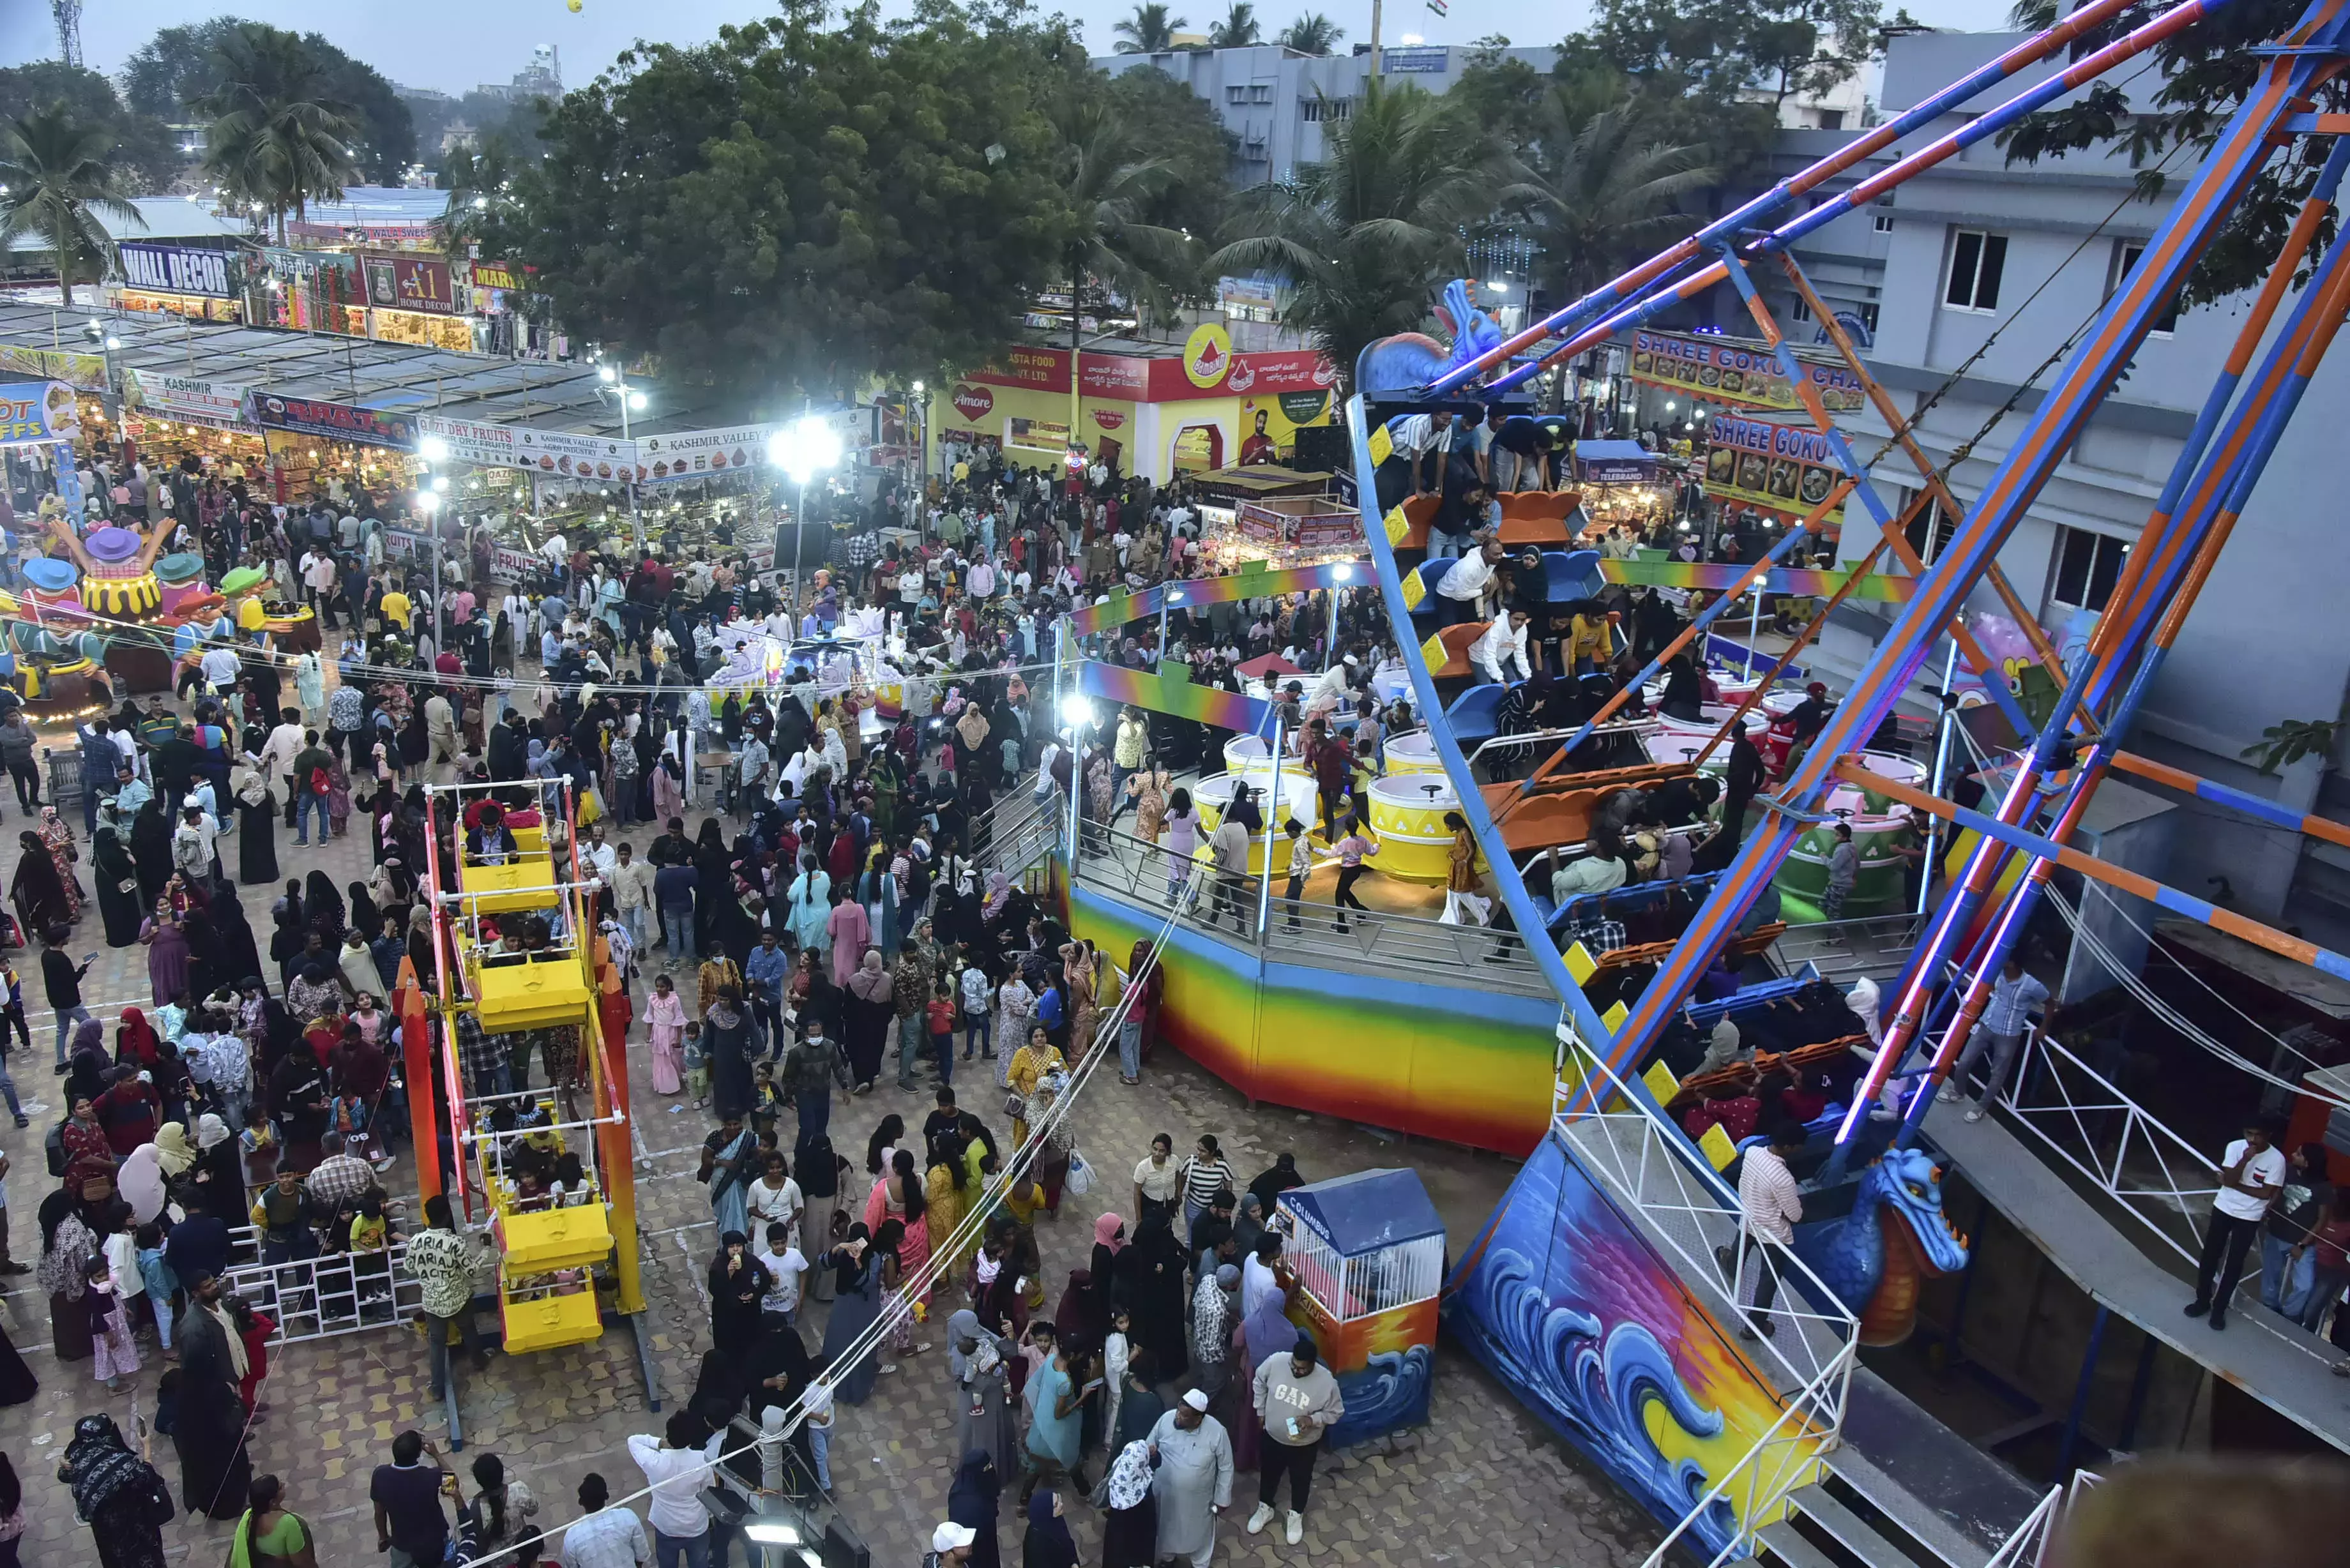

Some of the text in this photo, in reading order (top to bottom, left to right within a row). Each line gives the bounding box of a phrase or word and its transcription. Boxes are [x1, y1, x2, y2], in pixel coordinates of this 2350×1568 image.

[374, 229, 399, 238] WALA
[121, 248, 229, 292] WALL DECOR
[400, 298, 452, 313] HOME DECOR
[1031, 356, 1056, 368] FOOD
[1637, 334, 1711, 363] SHREE
[1717, 349, 1786, 378] GOKU
[1031, 370, 1049, 382] LTD.
[163, 377, 213, 395] KASHMIR
[953, 392, 991, 409] Amore
[174, 412, 216, 426] WELCOME
[420, 419, 512, 442] QZI DRY FRUITS
[459, 437, 478, 446] DRY
[479, 440, 513, 450] FRUITS
[540, 433, 599, 448] KASHMIR VALLEY
[669, 434, 720, 451] KASHMIR
[722, 430, 762, 444] VALLEY
[1712, 415, 1828, 464] SHREE GOKU
[543, 443, 562, 452] AGRO
[563, 446, 598, 456] INDUSTRY
[1600, 473, 1643, 481] TELEBRAND
[1289, 1196, 1331, 1240] COLUMBUS
[1274, 1383, 1310, 1410] GAP
